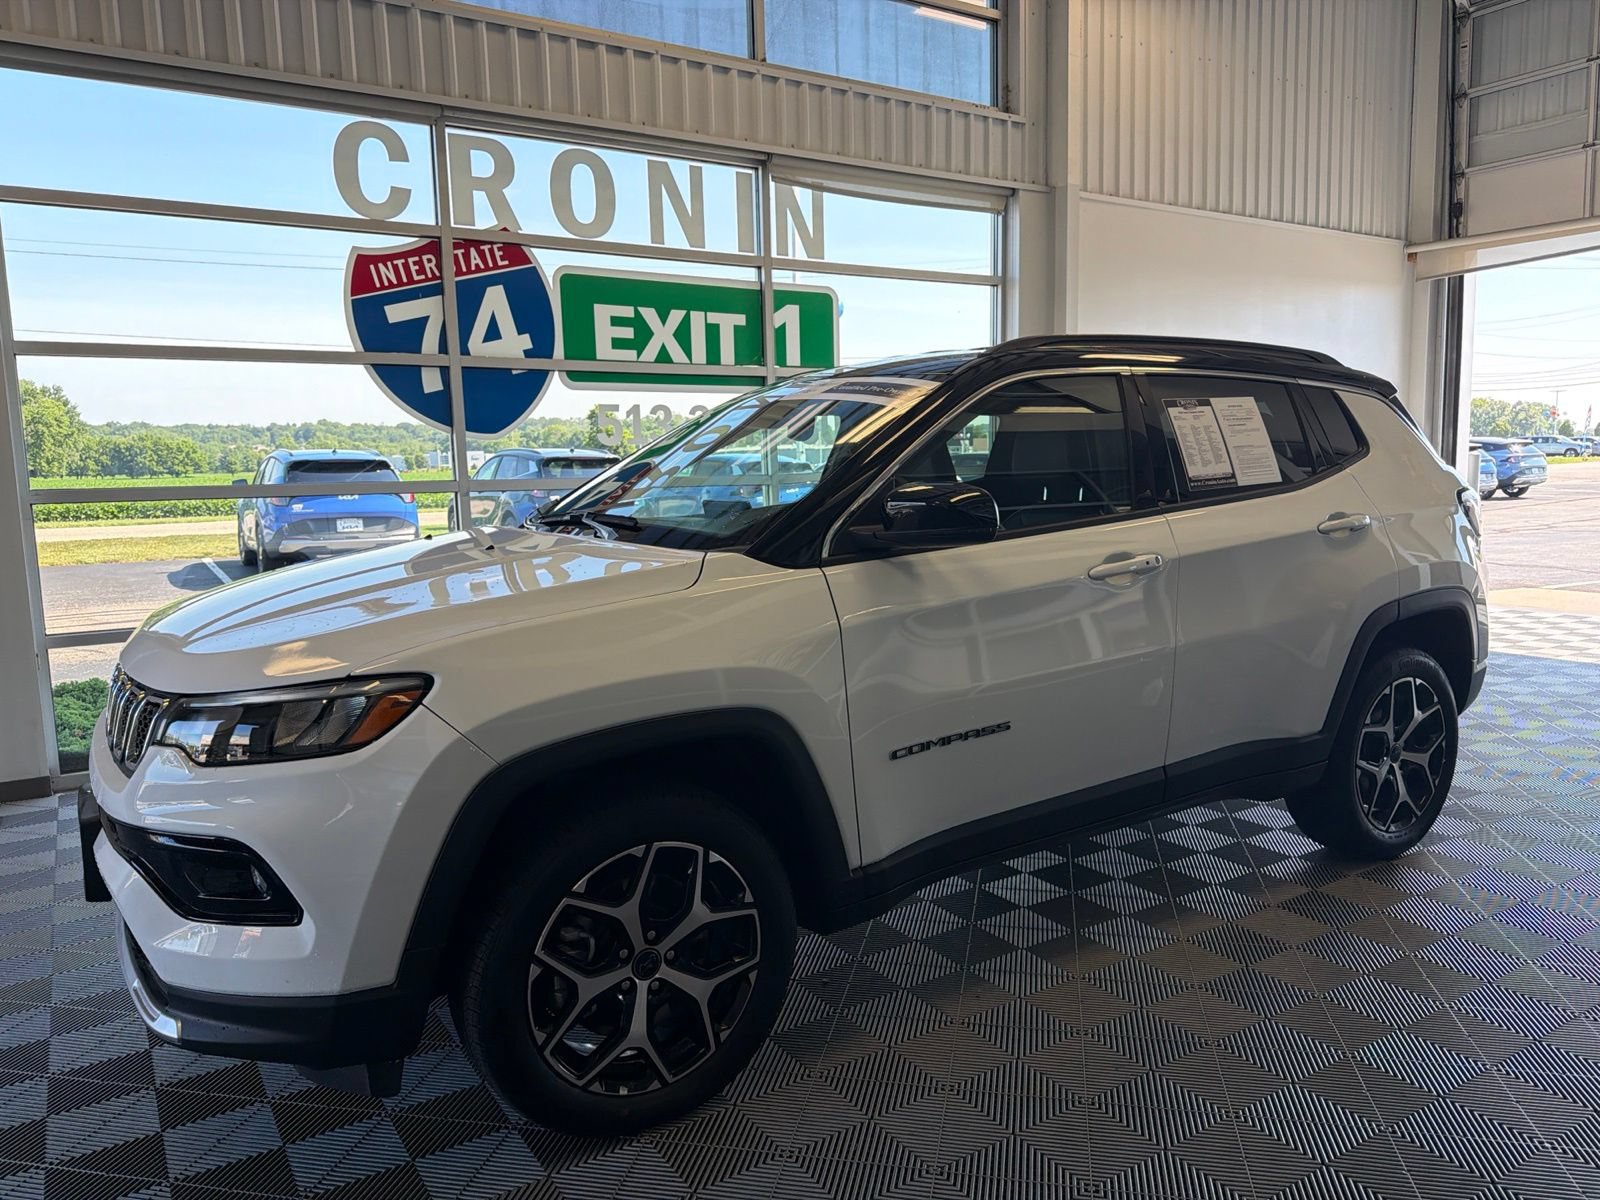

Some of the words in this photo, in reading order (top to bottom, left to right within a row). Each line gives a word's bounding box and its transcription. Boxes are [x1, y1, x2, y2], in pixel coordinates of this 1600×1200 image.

[333, 120, 824, 260] CRONIN
[369, 243, 510, 289] INTERTATE
[383, 284, 534, 394] 74
[593, 303, 746, 366] EXIT
[773, 304, 801, 367] 1
[889, 720, 1012, 761] COMPASS
